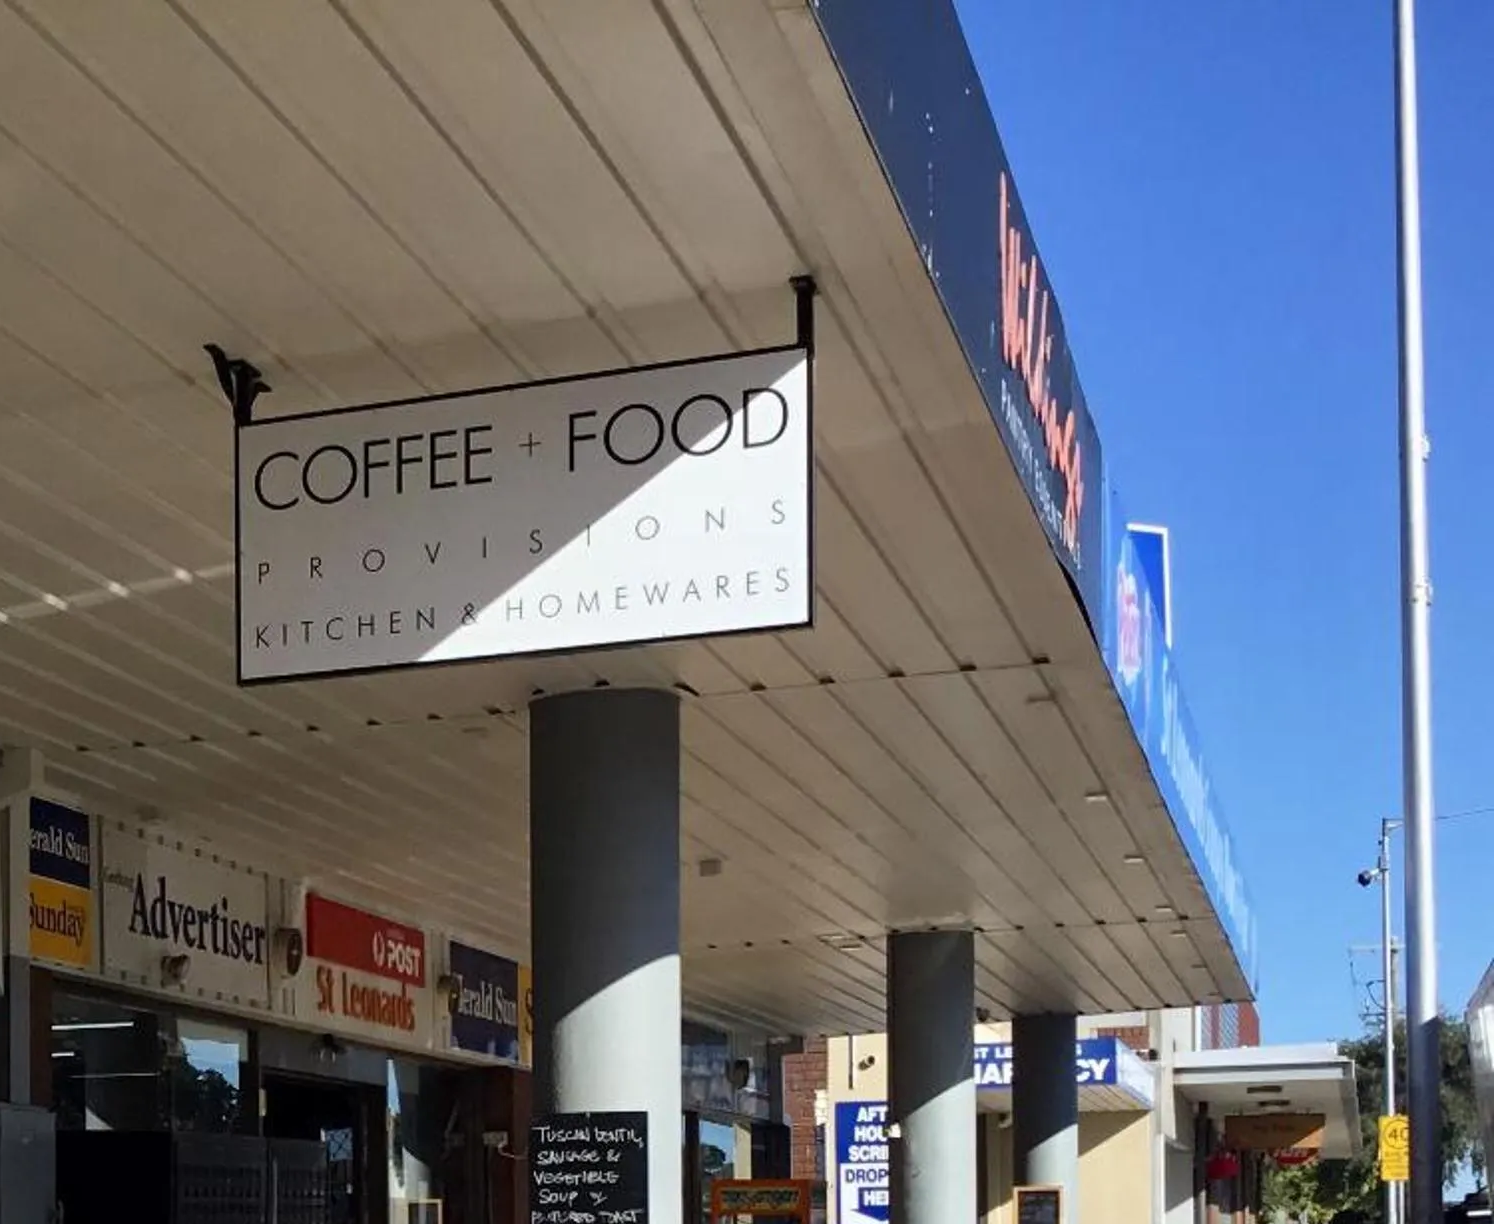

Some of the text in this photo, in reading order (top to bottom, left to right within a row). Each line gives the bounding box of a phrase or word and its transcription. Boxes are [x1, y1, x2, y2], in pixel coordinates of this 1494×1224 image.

[254, 424, 493, 510] COFFEE
[568, 386, 789, 473] FOOD
[257, 498, 787, 585] PROVISIONS
[254, 566, 791, 650] KITCHEN & HOMEWARES
[29, 825, 90, 866] erald Sun
[128, 871, 266, 966] Advertiser
[387, 938, 422, 978] POST
[316, 964, 416, 1033] St Leonards
[853, 1125, 888, 1143] HOU
[856, 1105, 889, 1123] AFT
[847, 1144, 890, 1163] SCRI
[538, 1188, 579, 1208] SOUP
[862, 1190, 890, 1207] HE
